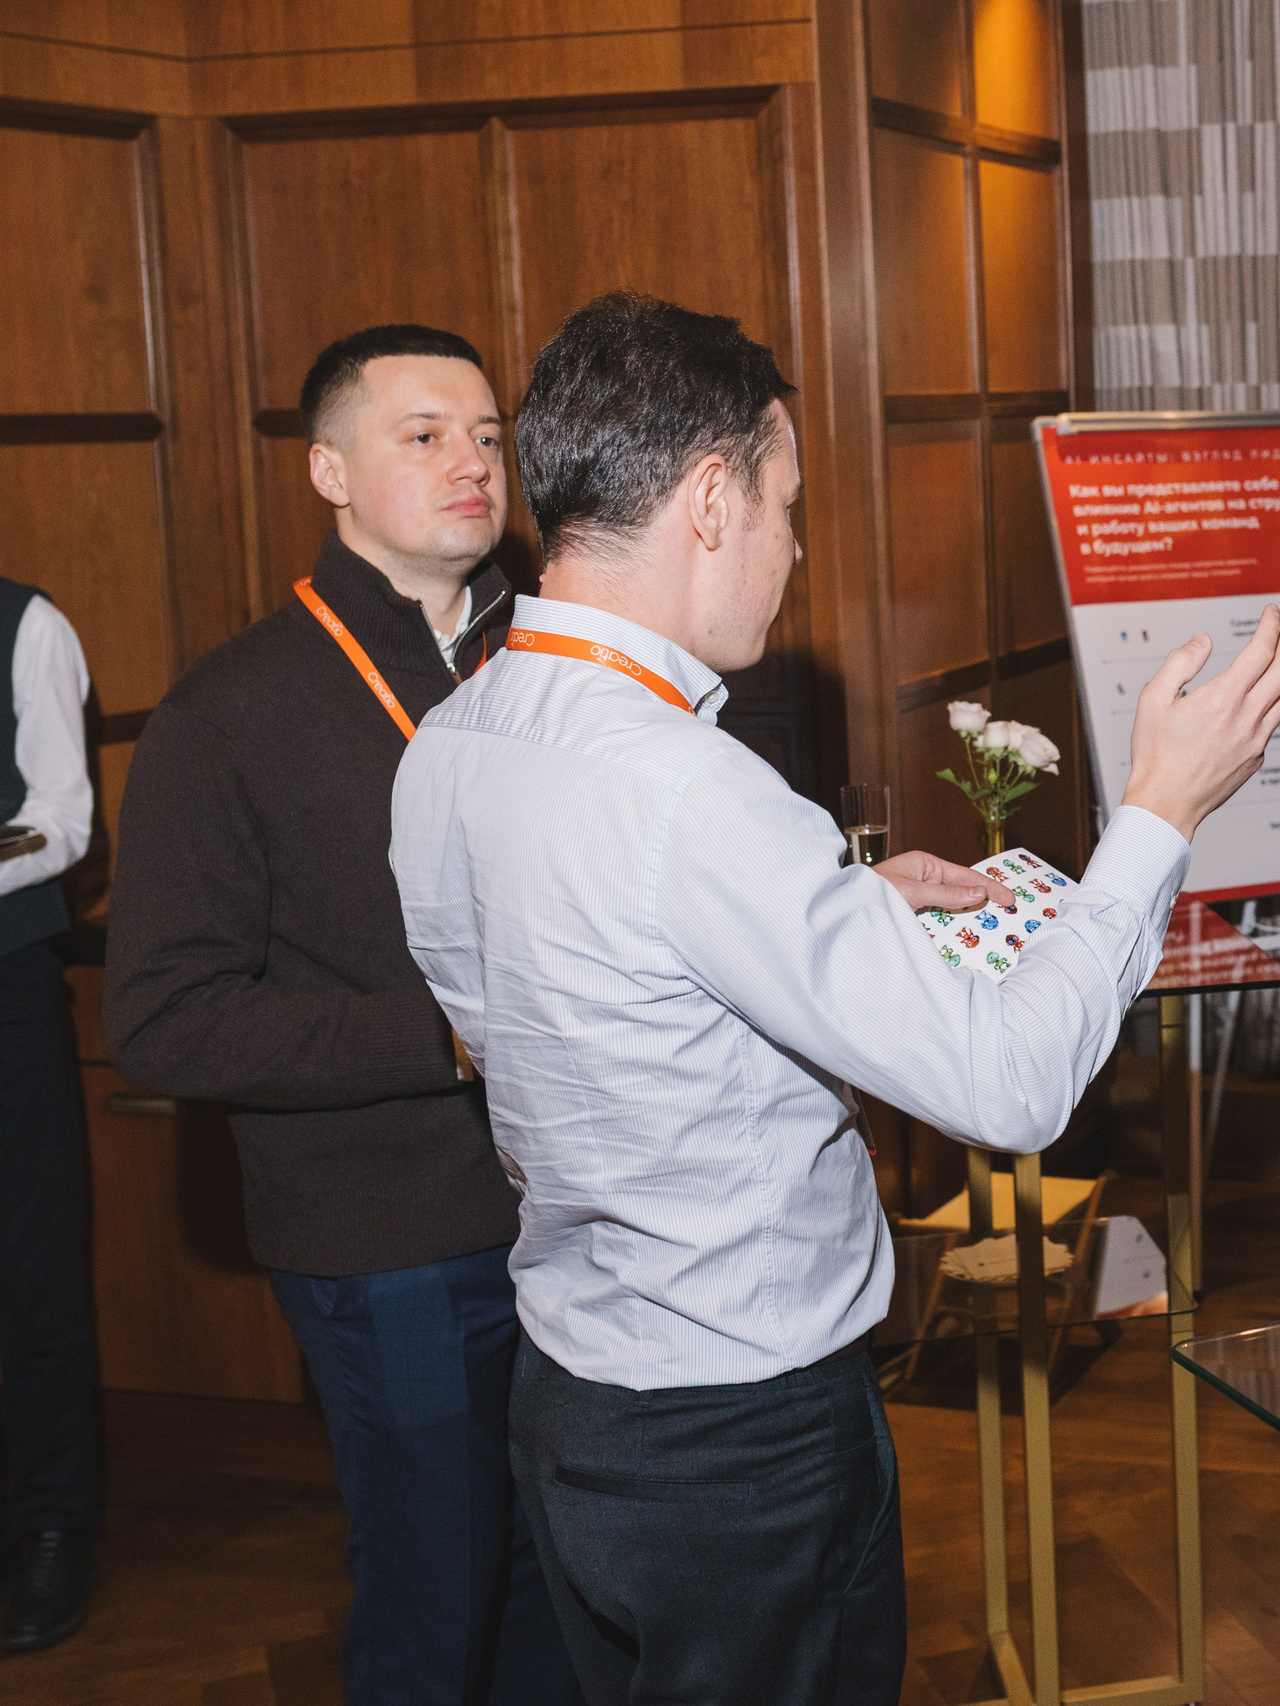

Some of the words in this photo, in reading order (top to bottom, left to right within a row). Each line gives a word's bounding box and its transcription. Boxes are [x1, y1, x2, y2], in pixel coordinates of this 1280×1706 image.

[1069, 484, 1100, 498] Как
[1102, 484, 1126, 497] вы
[1126, 480, 1241, 499] представляете
[1243, 476, 1280, 491] себе
[1073, 502, 1141, 517] влияние
[1143, 499, 1225, 514] AI-агентов
[1227, 498, 1246, 510] на
[1076, 524, 1089, 536] и
[1091, 519, 1145, 537] работу
[1148, 520, 1198, 533] ваших
[1201, 517, 1260, 530] команд
[1080, 542, 1092, 555] в
[1092, 536, 1173, 557] будущем?
[316, 605, 343, 637] Creatio
[590, 644, 643, 676] Creatio
[367, 671, 396, 708] Creatio
